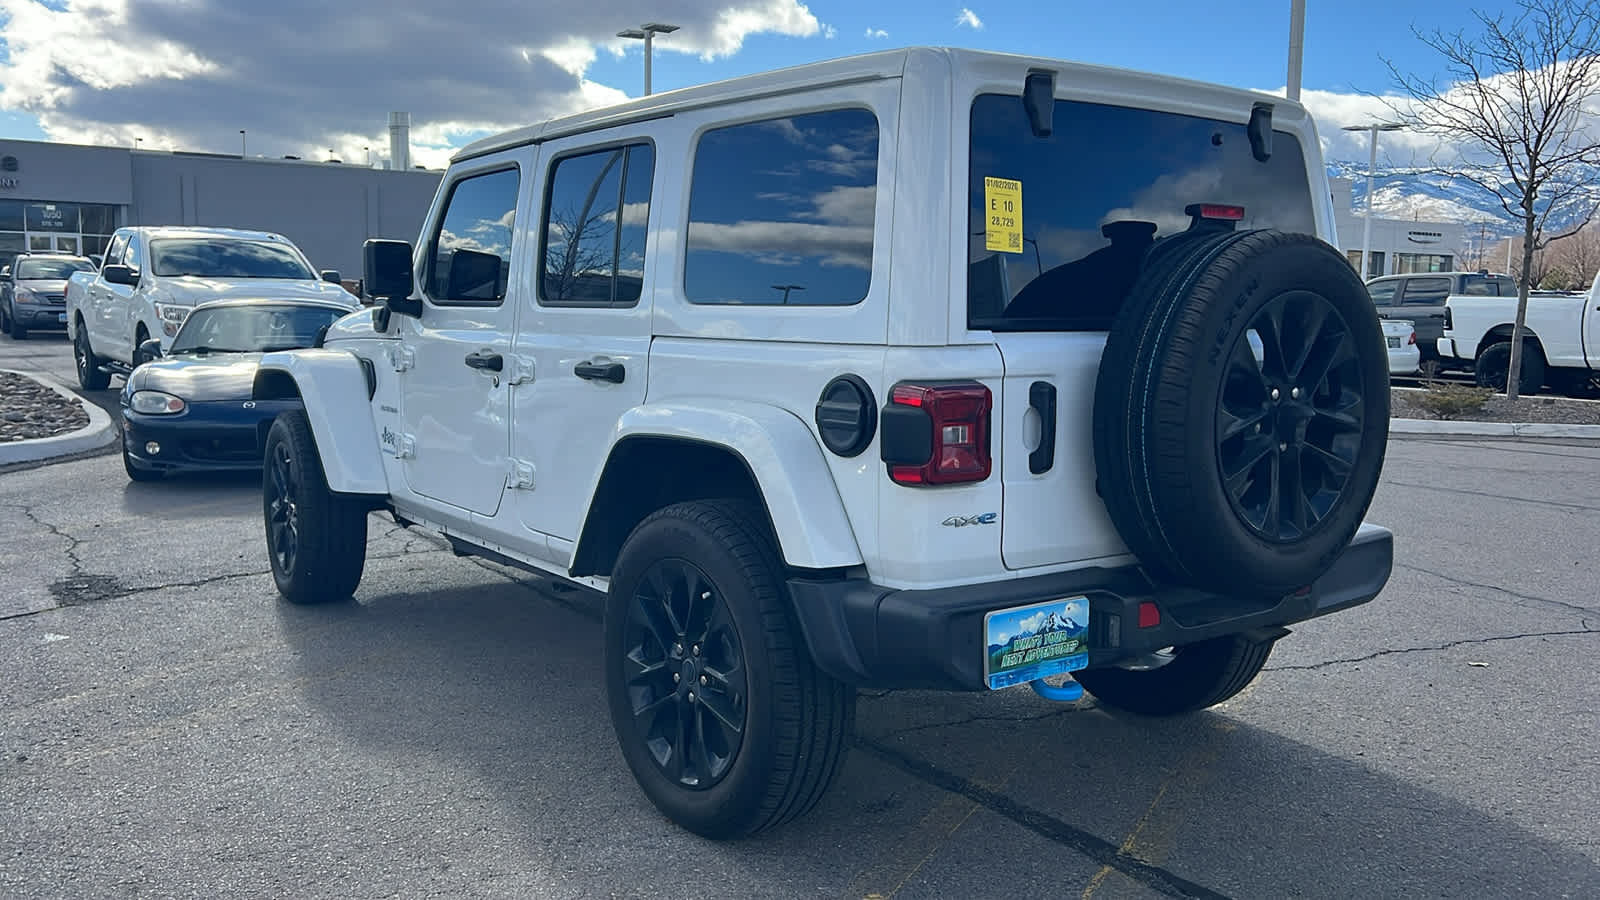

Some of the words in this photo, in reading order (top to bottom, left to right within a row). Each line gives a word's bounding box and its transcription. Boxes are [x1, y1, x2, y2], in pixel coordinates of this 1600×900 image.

[991, 199, 997, 210] E
[1003, 200, 1013, 213] 10
[1043, 630, 1068, 645] YOUR
[1001, 652, 1026, 668] NEXT
[1024, 640, 1079, 663] ADVENTURE?
